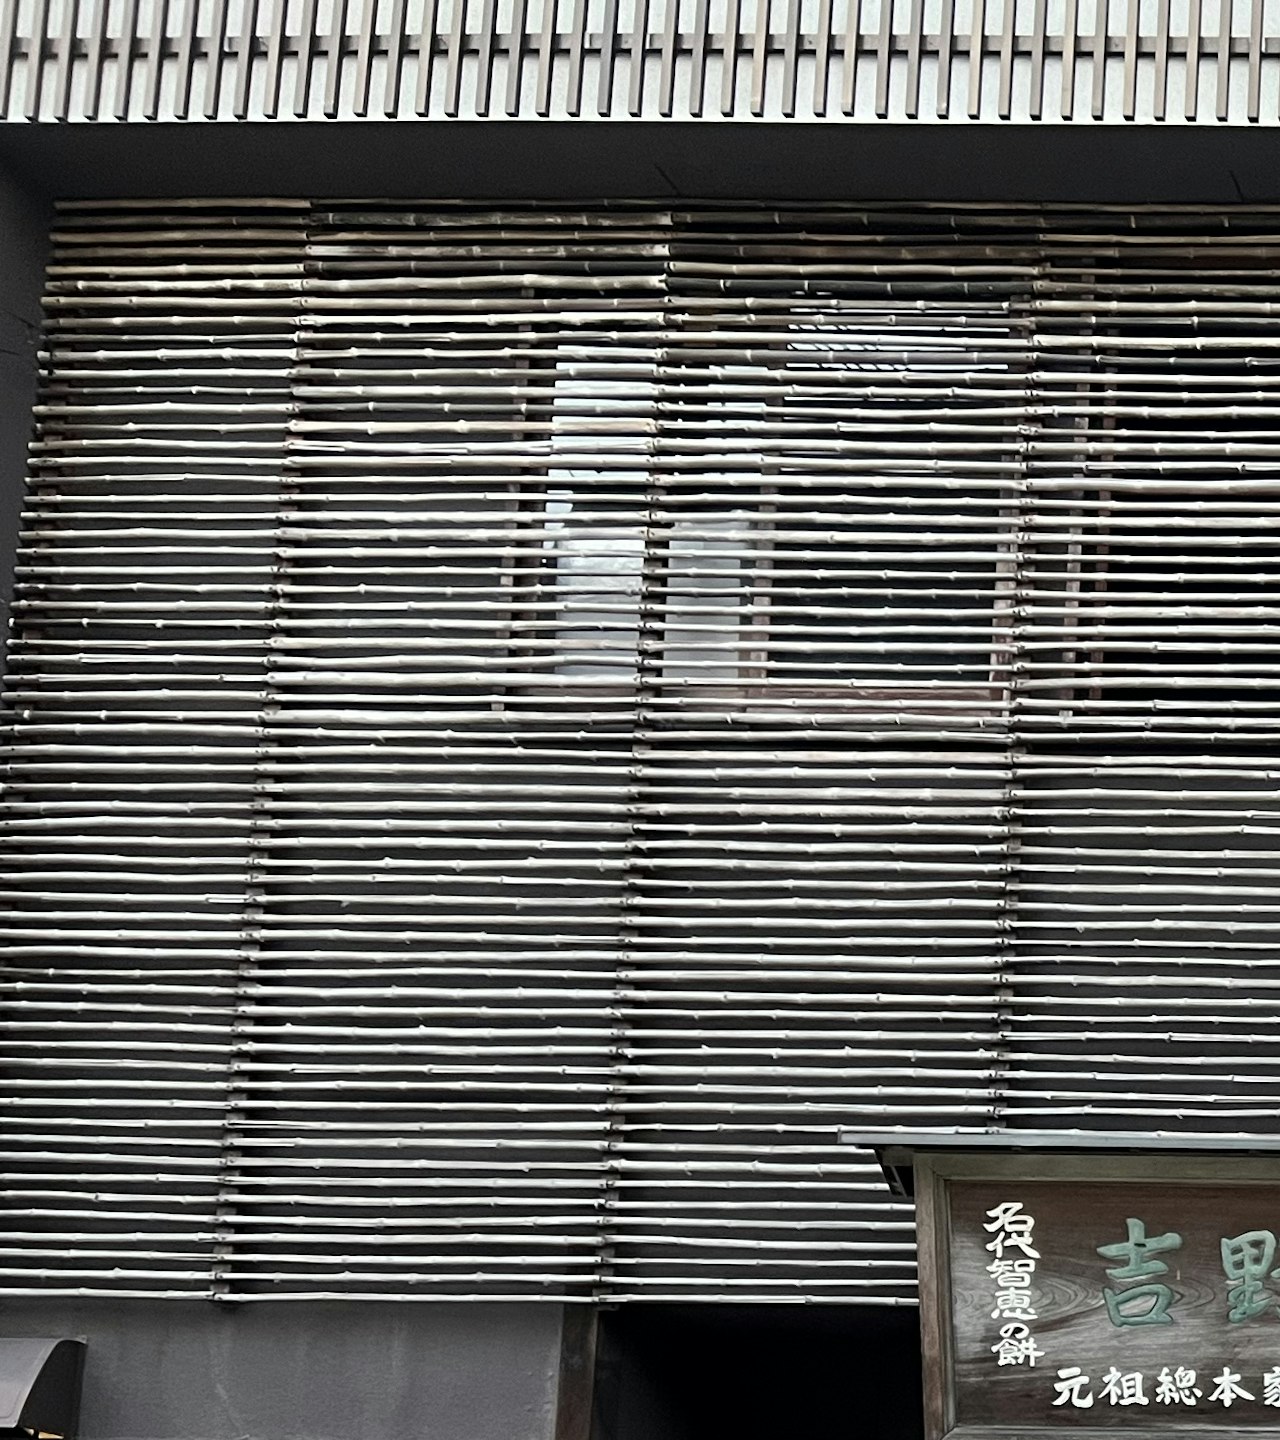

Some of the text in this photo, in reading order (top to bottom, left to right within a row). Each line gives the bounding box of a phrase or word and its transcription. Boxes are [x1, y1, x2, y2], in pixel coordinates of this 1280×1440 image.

[983, 1202, 1046, 1367] 名代智恵の餅
